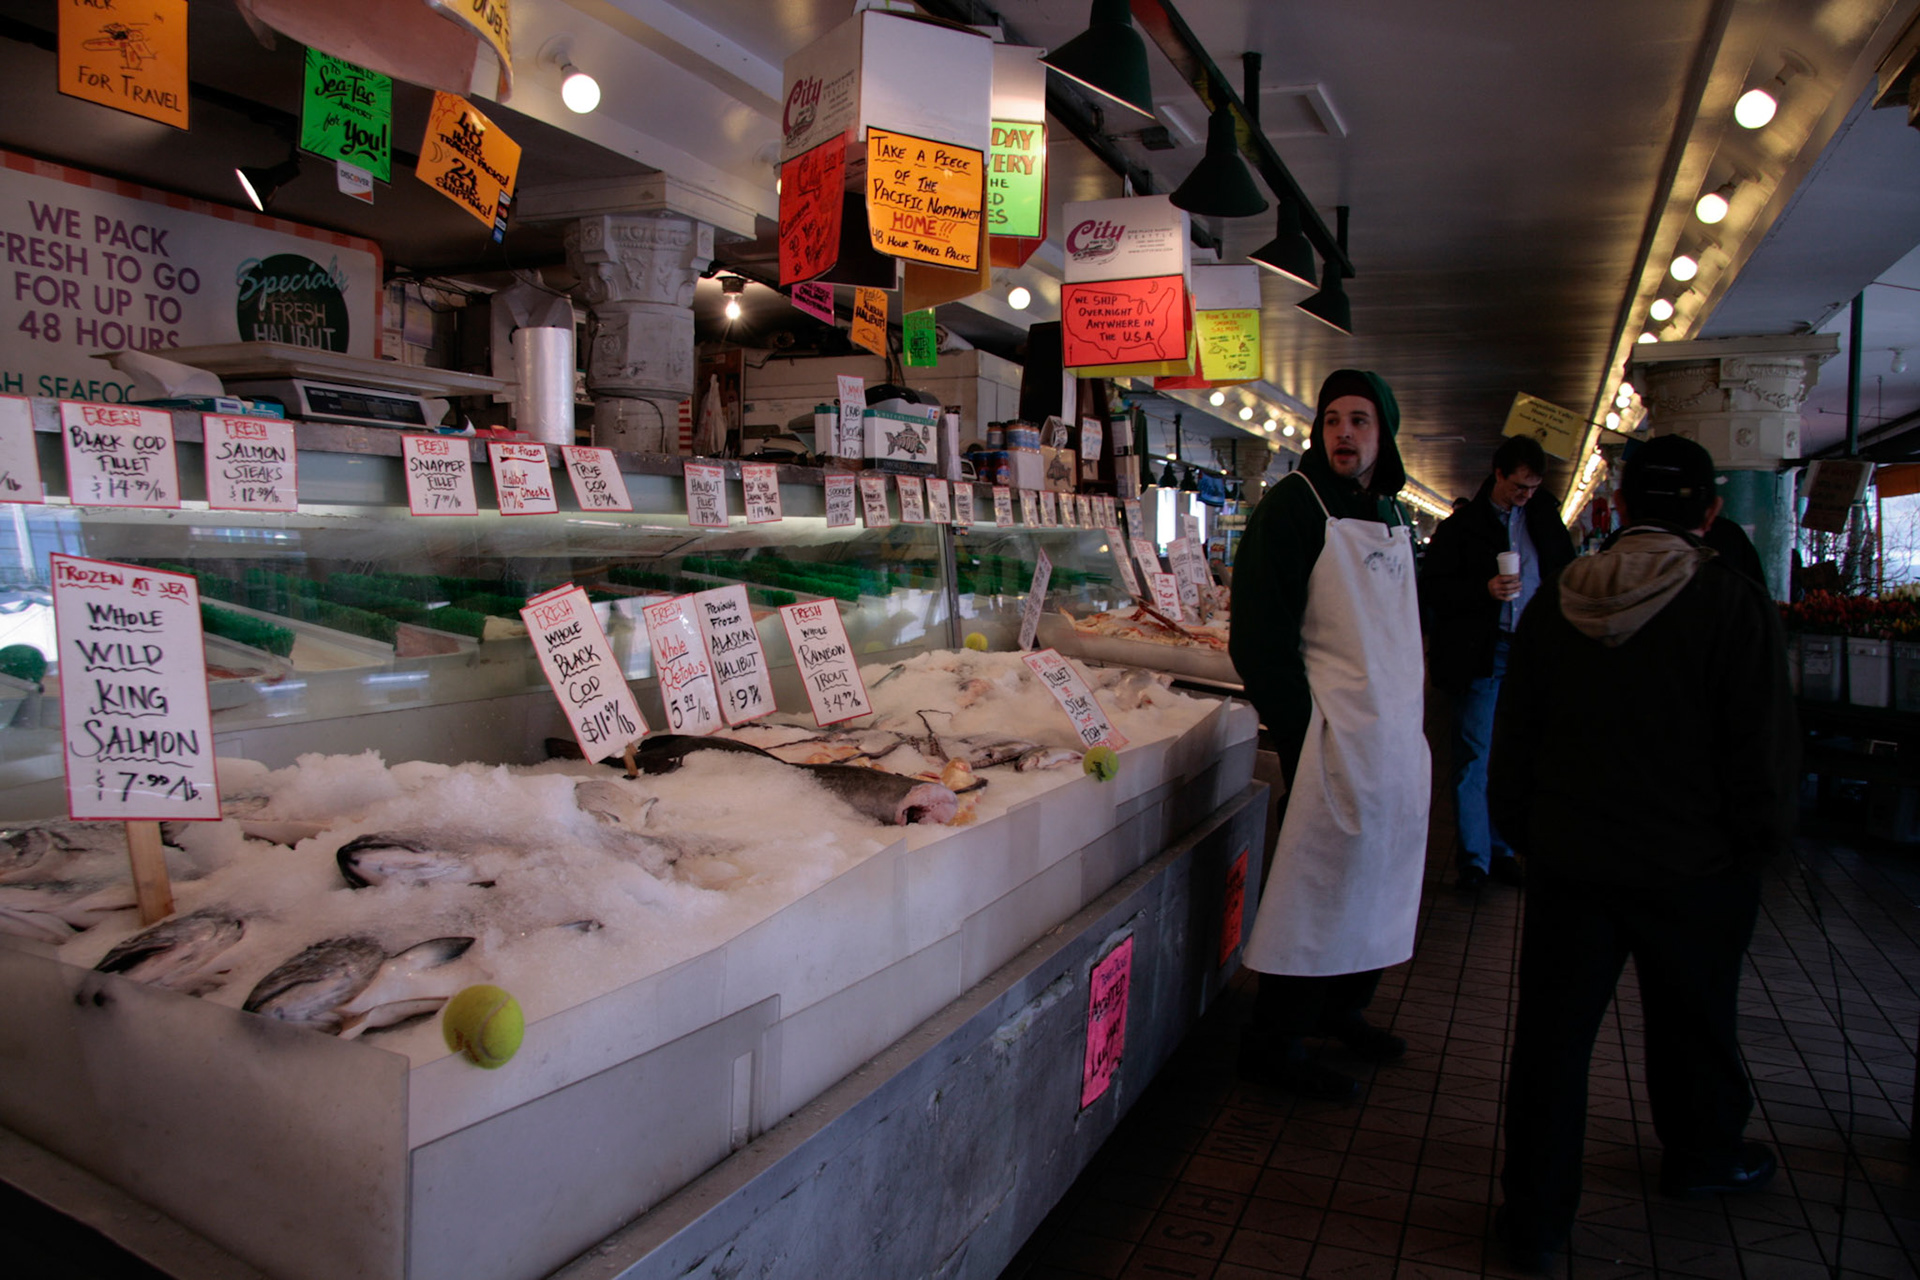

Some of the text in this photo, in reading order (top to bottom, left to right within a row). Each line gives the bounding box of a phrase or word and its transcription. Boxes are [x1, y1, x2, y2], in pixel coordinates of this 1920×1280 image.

[79, 65, 182, 112] FOR TRAVEL
[871, 136, 971, 170] TAKE A PIECE
[873, 178, 923, 211] PACIFIC
[894, 169, 938, 194] OF THE
[28, 200, 170, 258] WE PACK
[1066, 219, 1126, 254] City
[913, 239, 941, 257] TRAVEL
[946, 246, 972, 263] PACKS
[103, 251, 142, 284] TO
[153, 262, 201, 295] GO
[235, 255, 350, 312] Specials
[15, 271, 183, 325] FOR UP TO
[1093, 296, 1118, 305] SHIP
[271, 302, 328, 327] FRESH
[1079, 307, 1132, 317] OVERNIGHT
[1086, 318, 1155, 329] ANYWHERE IN
[18, 310, 181, 351] 48 HOURS
[253, 323, 338, 351] HALIBUT
[82, 406, 141, 425] FRESH
[223, 420, 269, 437] FRESH
[70, 425, 167, 451] BLACK COD
[416, 439, 450, 455] FRESH
[97, 455, 151, 473] FILLET
[216, 442, 286, 461] SALMON
[569, 447, 600, 461] FRESH
[223, 464, 284, 480] STEAKS
[409, 457, 466, 474] SNAPPER
[571, 462, 601, 477] TRUE
[427, 476, 458, 490] FILLET
[54, 561, 189, 598] FROZEN AT SEA
[86, 601, 164, 626] WHOLE
[532, 600, 575, 630] FRESH
[651, 604, 683, 624] FRESH
[790, 604, 823, 621] FRESH
[545, 620, 583, 647] WHOLE
[711, 627, 757, 653] ALASKAN
[74, 639, 163, 666] WILD
[656, 634, 688, 661] Whole
[798, 643, 847, 670] RAINBOW
[553, 645, 602, 678] BLACK
[715, 651, 758, 680] HALIBUT
[95, 679, 169, 714] KING
[569, 676, 601, 704] COD
[70, 719, 200, 758] SALMON
